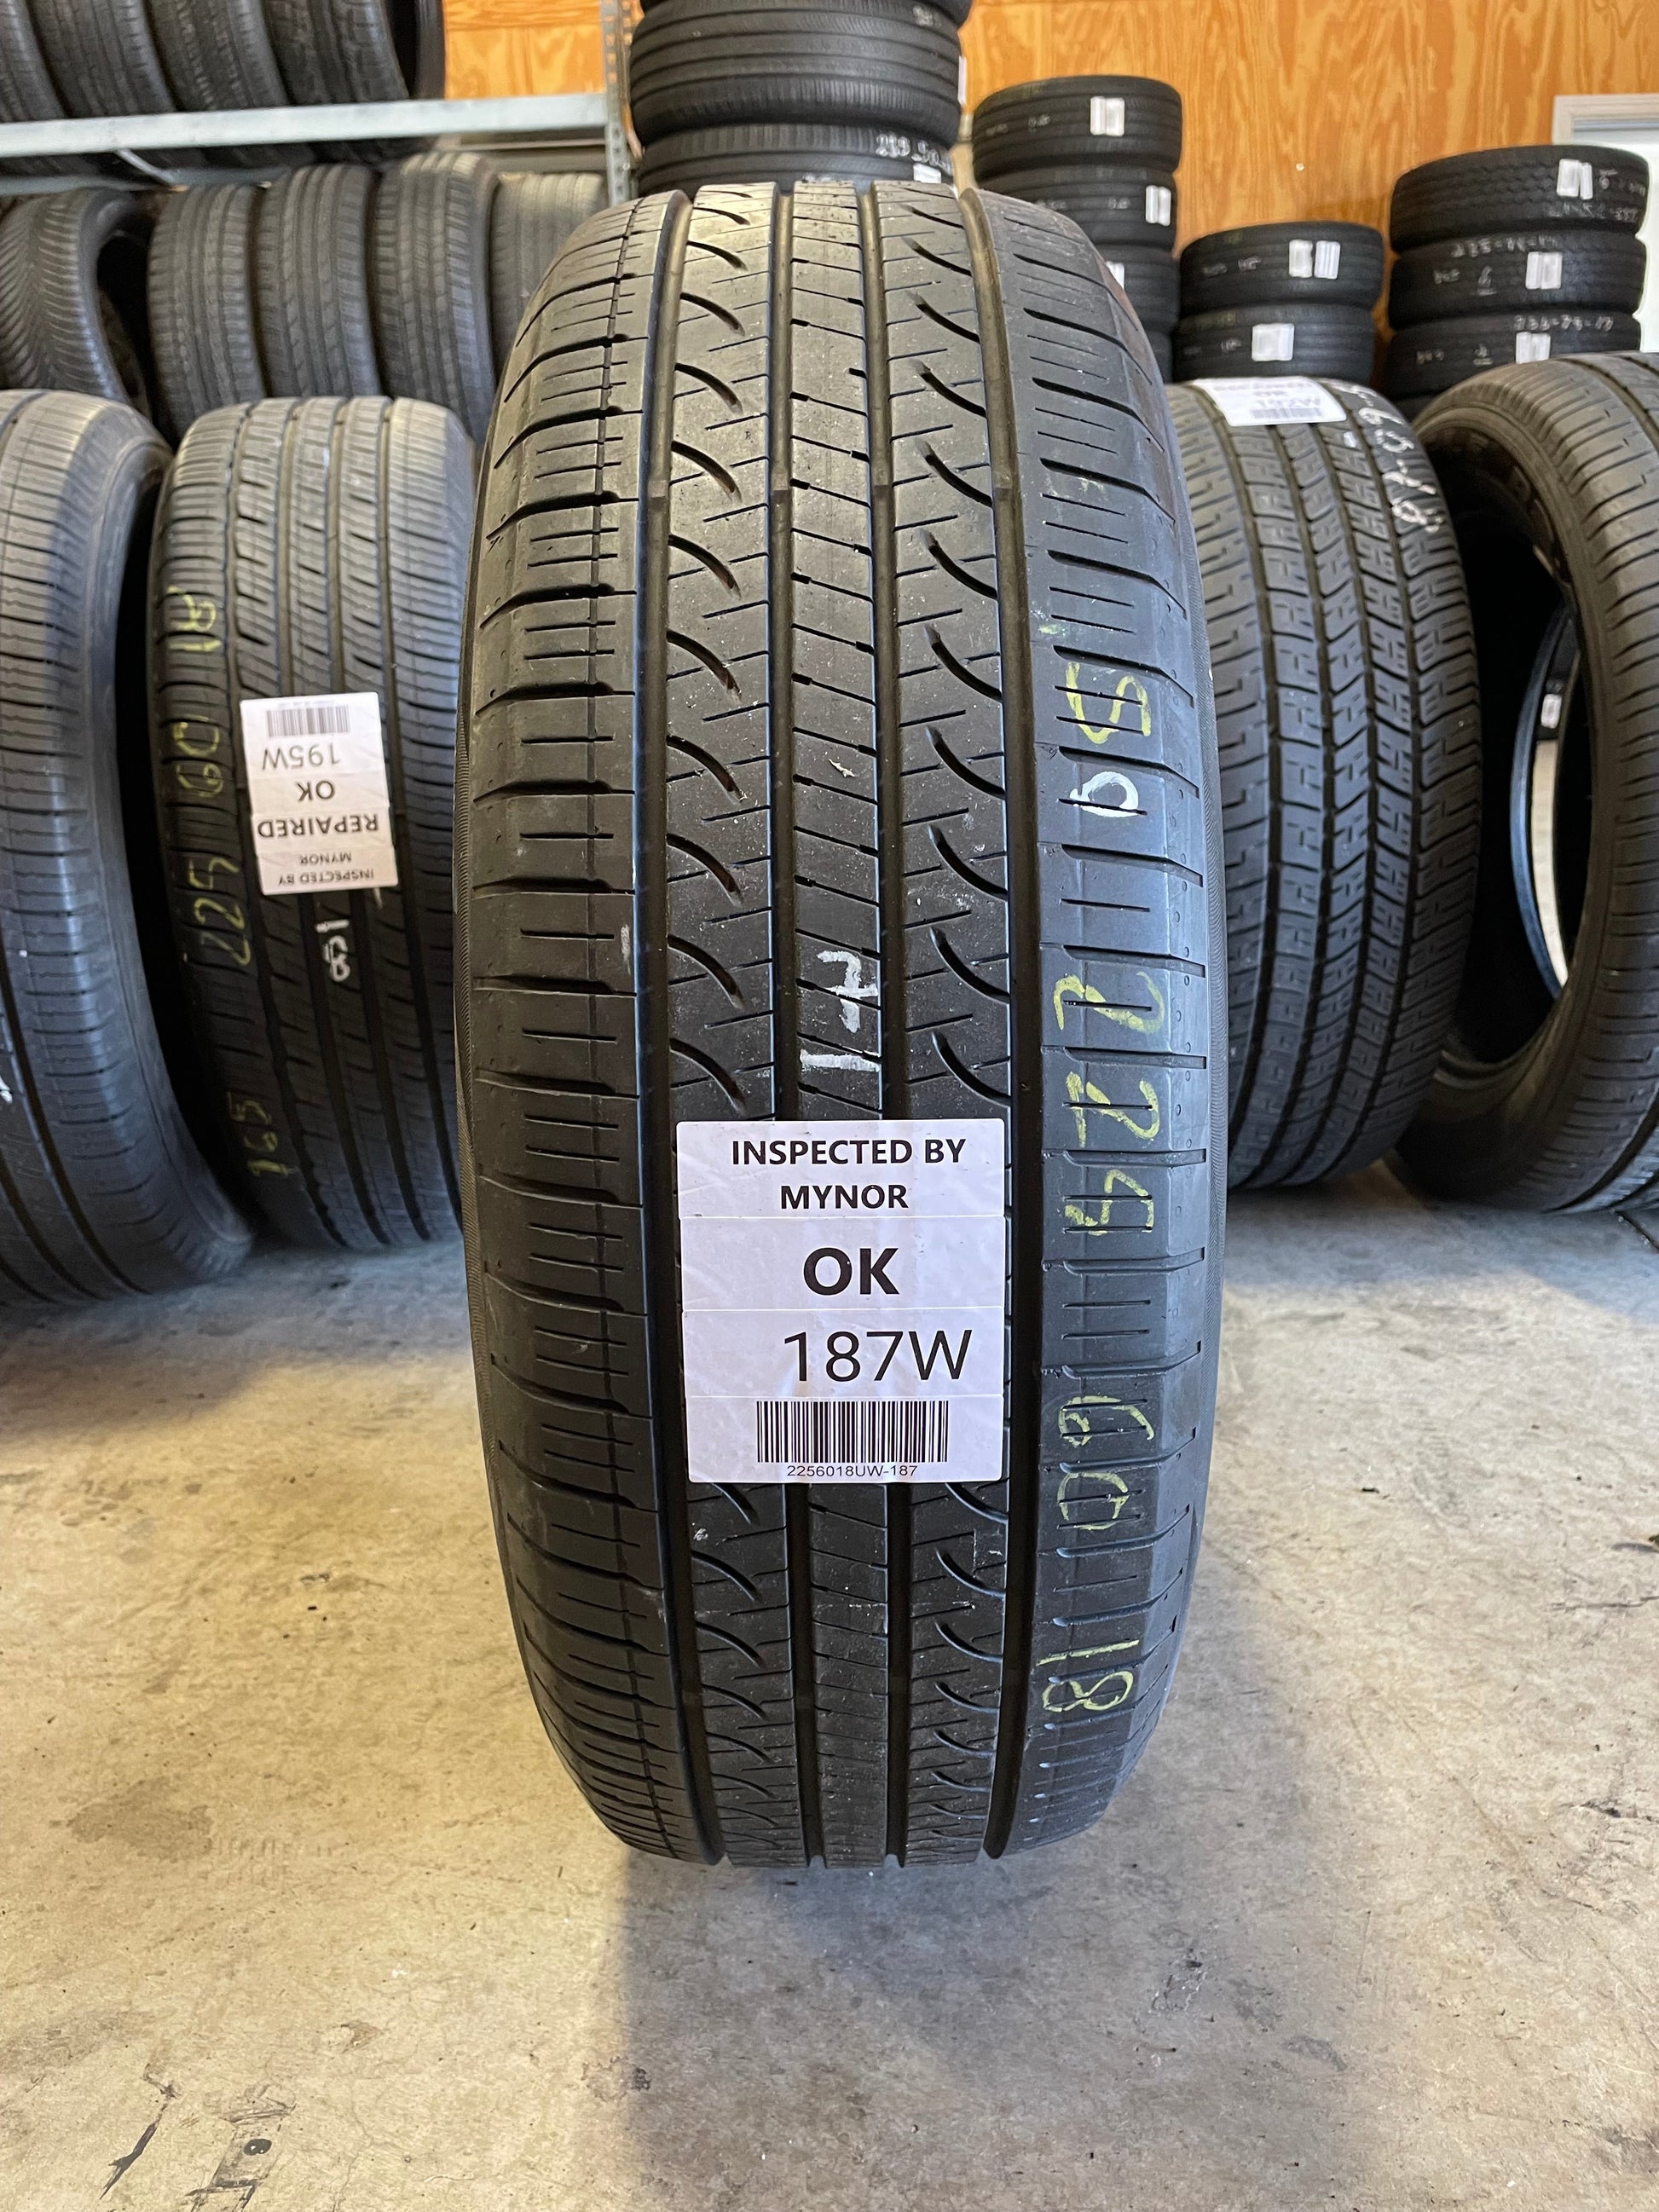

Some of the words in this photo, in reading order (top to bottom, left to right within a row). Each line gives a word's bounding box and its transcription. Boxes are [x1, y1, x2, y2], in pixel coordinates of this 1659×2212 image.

[262, 742, 341, 771] 195W
[296, 780, 335, 802] OK
[257, 813, 379, 839] REPAIRED
[300, 852, 352, 865] MYNOR
[278, 874, 294, 887] BY
[300, 869, 374, 884] INSPECTED
[1054, 970, 1165, 1235] 225
[731, 1141, 913, 1165] INSPECTED
[924, 1139, 967, 1164] BY
[780, 1185, 909, 1210] MYNOR
[803, 1247, 900, 1296] OK
[783, 1329, 973, 1383] 187W
[786, 1464, 918, 1478] 2256018UW-187
[1058, 1395, 1154, 1531] 60
[1037, 1638, 1140, 1713] 18
